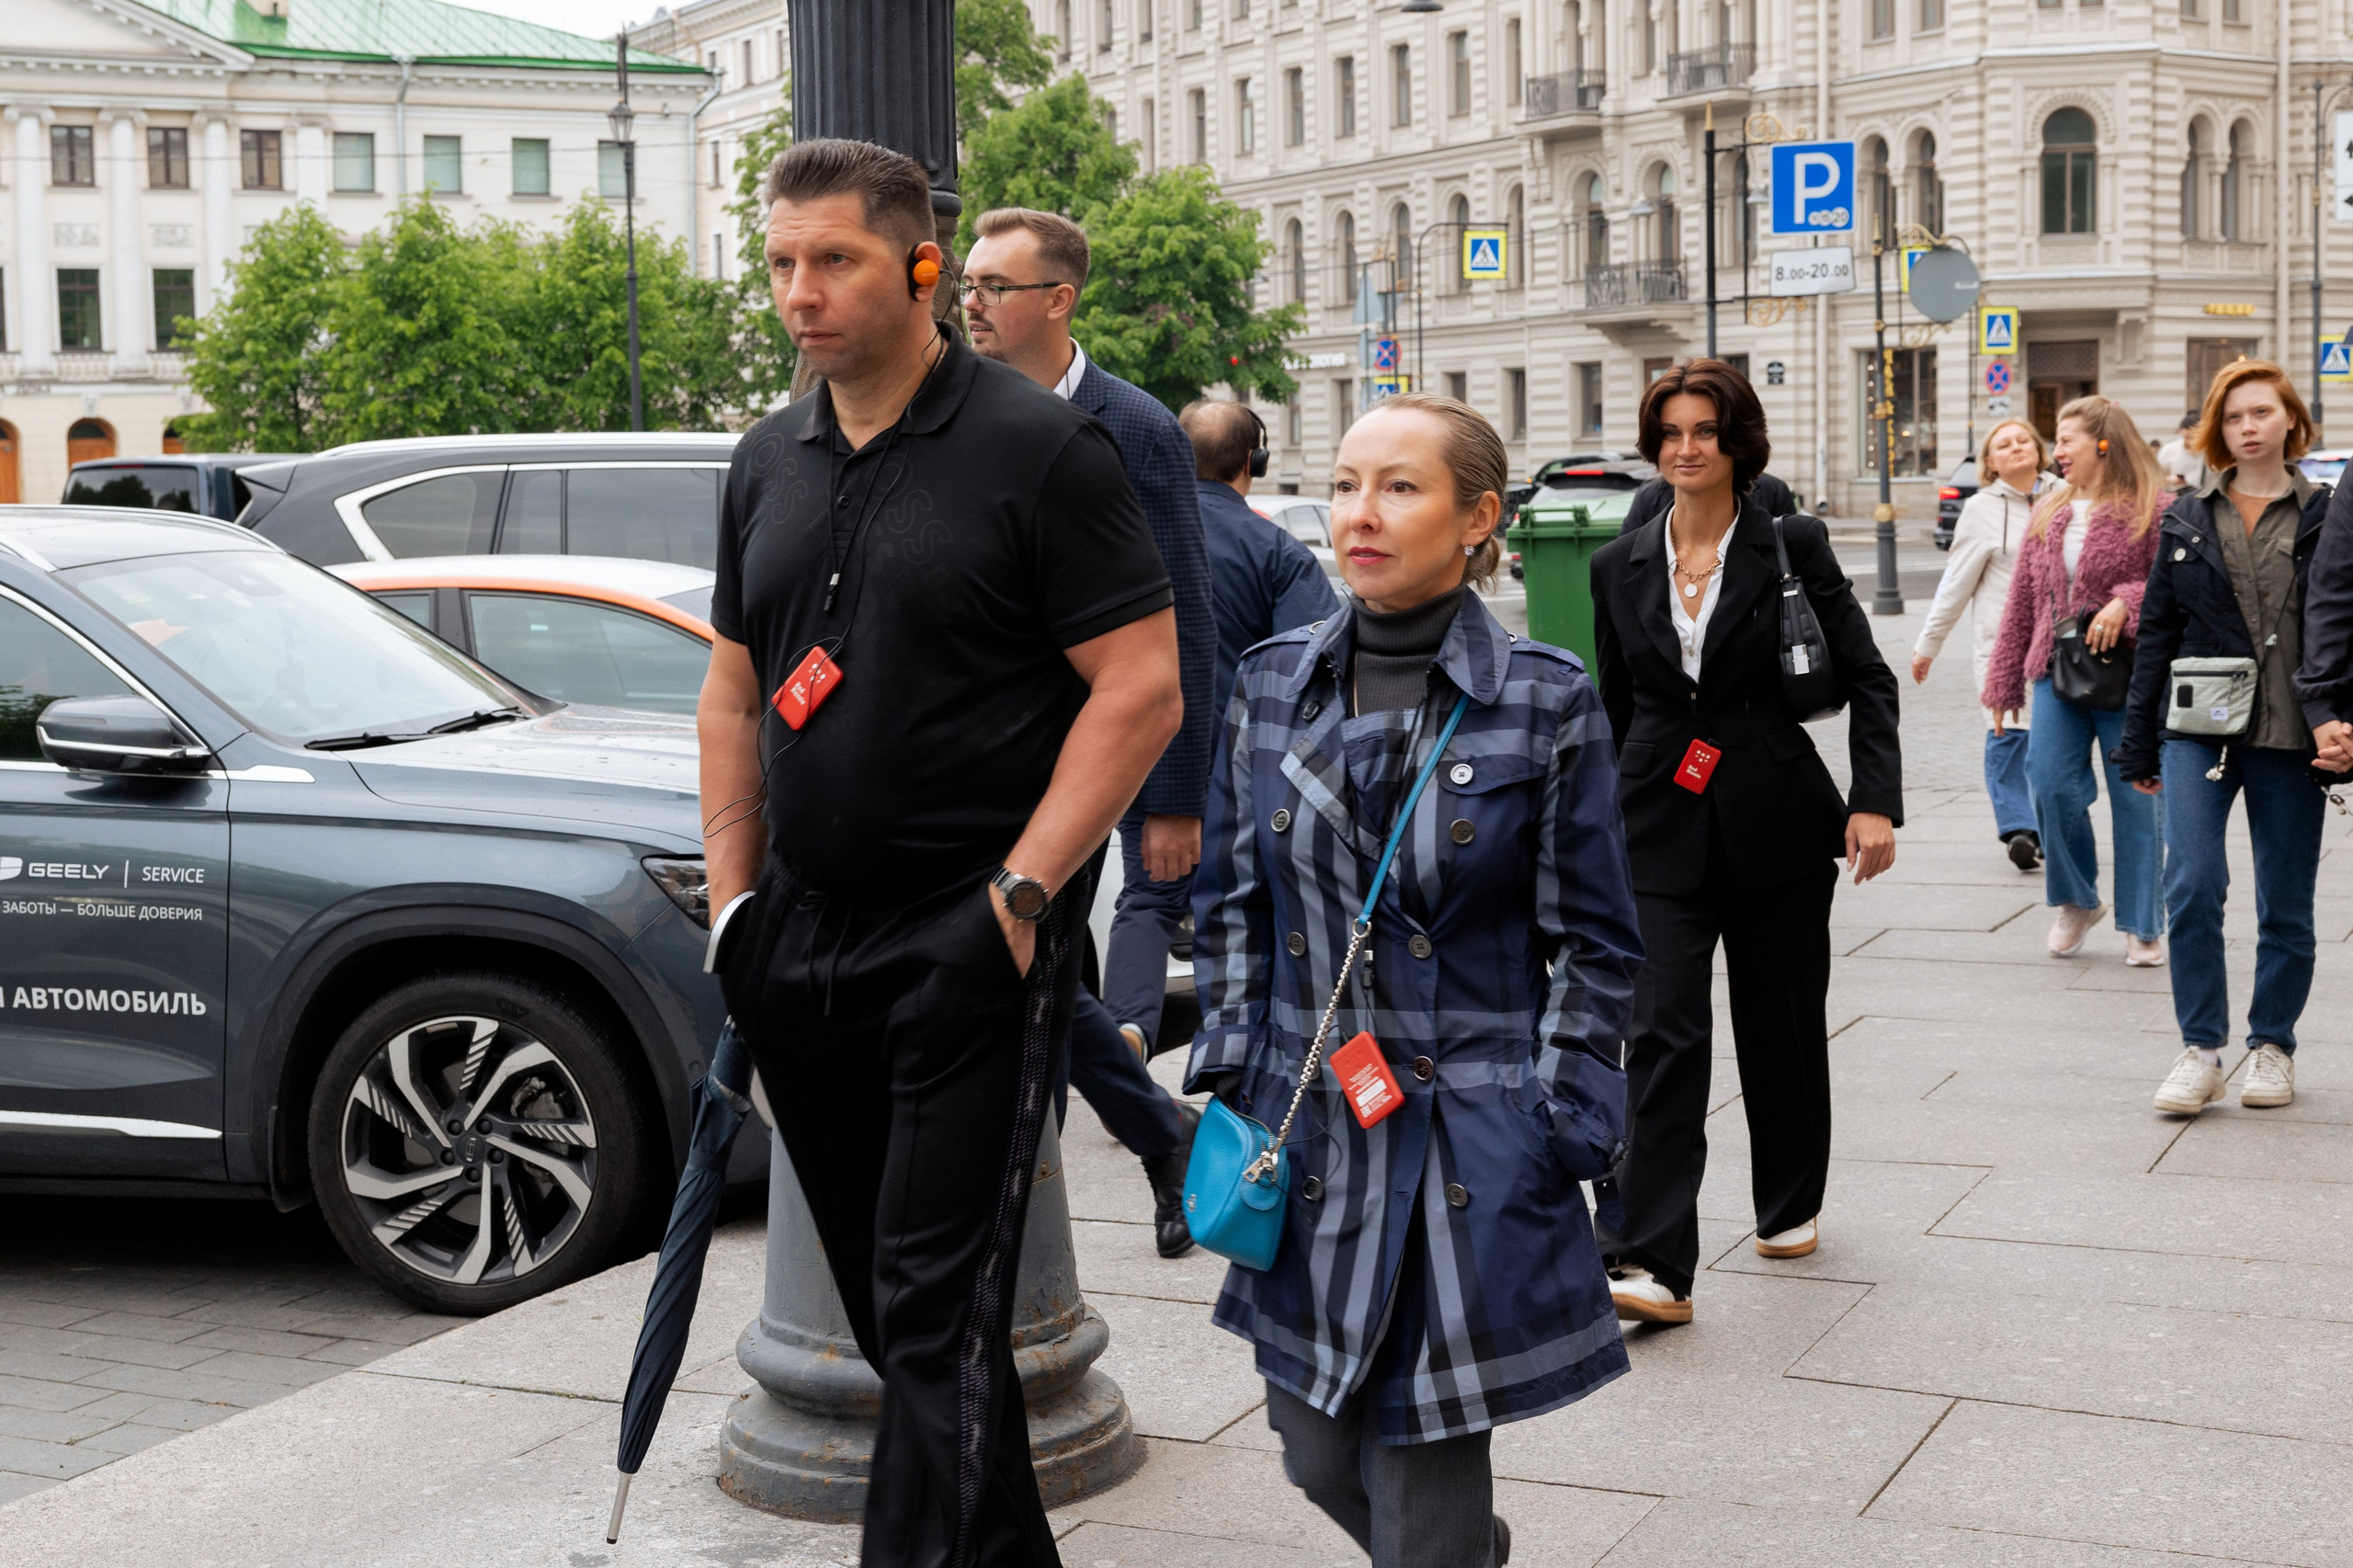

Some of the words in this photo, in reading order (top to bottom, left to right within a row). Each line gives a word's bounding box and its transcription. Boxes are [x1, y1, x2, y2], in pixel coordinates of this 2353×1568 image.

[1794, 153, 1841, 224] P
[1776, 263, 1849, 280] 8.00-20.00
[28, 862, 109, 880] GEELY
[142, 866, 205, 883] SERVICE
[2, 901, 56, 915] ЗАБОТЫ
[77, 903, 136, 918] БОЛЬШЕ
[139, 905, 203, 921] ДОВЕРИЯ
[12, 987, 207, 1016] АВТОМОБИЛЬ
